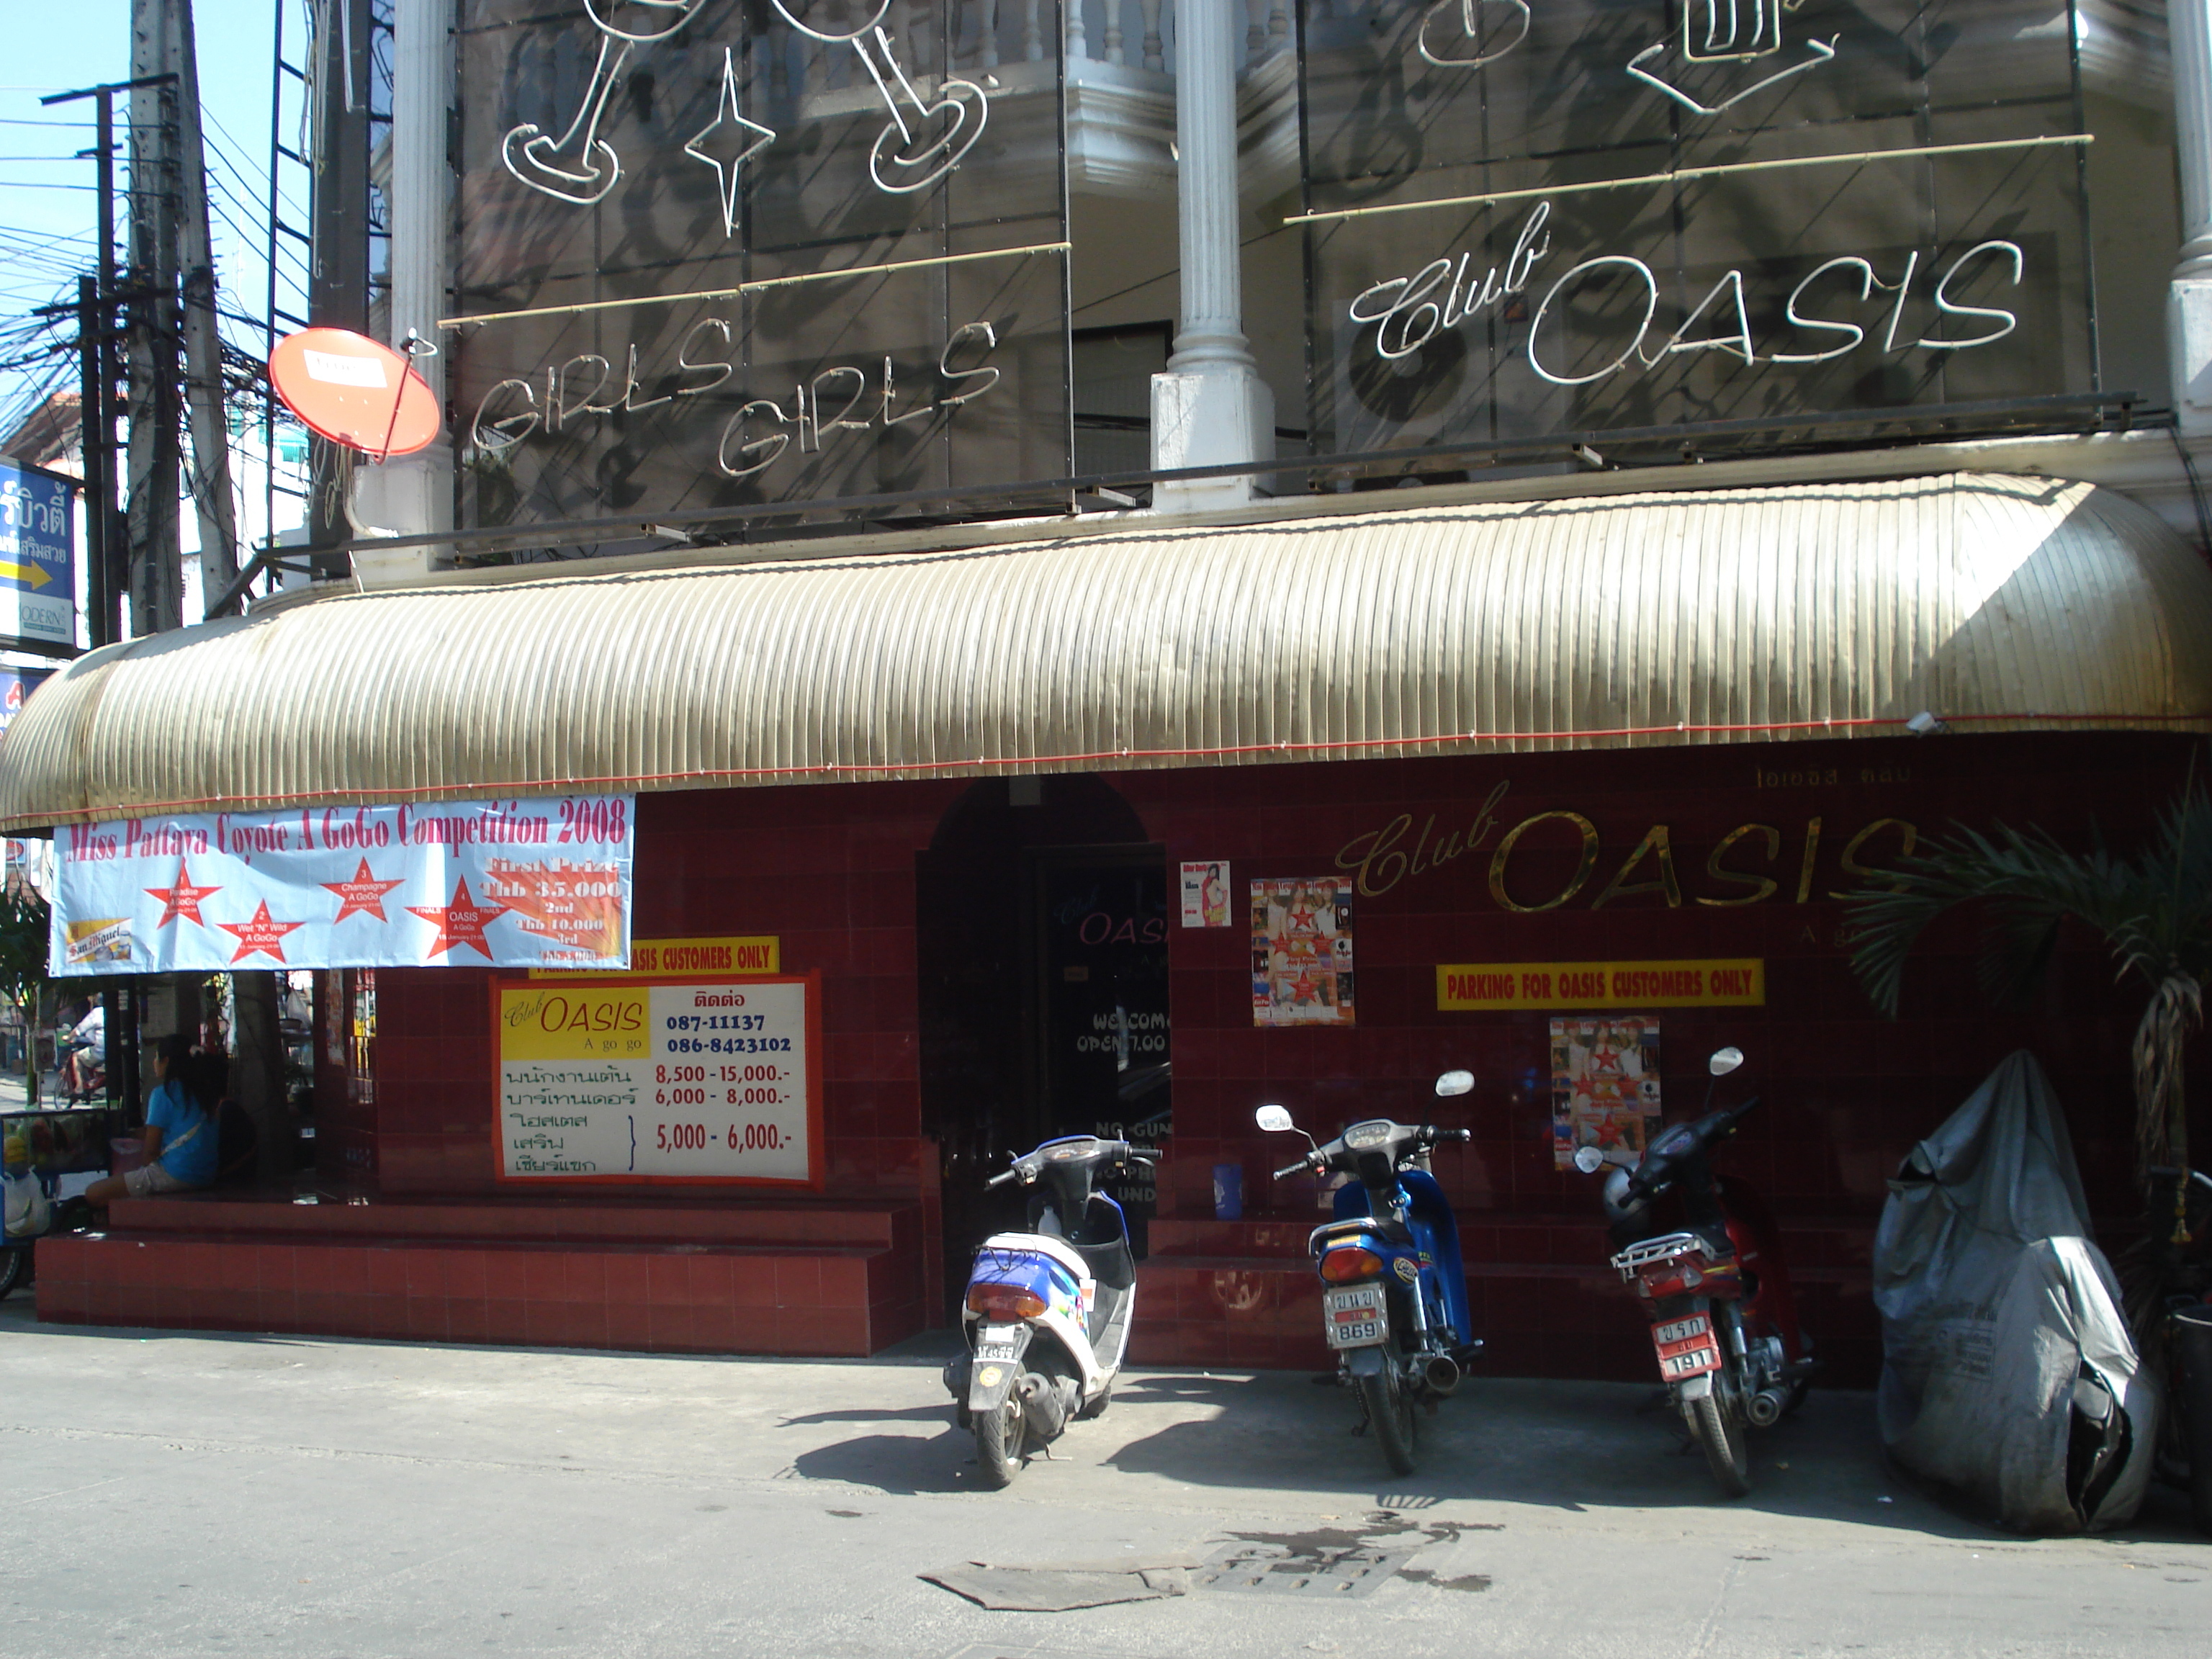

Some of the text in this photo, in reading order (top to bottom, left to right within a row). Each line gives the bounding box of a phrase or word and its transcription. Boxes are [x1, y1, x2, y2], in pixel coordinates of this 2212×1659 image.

[1350, 200, 2023, 385] Club OASIS
[472, 317, 734, 451] GIRLS
[719, 320, 999, 477] GIRLS
[19, 602, 60, 626] ODERN
[66, 799, 626, 866] Miss Pattaya Coyote A GoGo Competition 2008
[1335, 780, 1918, 913] Club OASIS
[361, 866, 367, 878] 3
[485, 858, 619, 873] First Prize
[341, 883, 387, 891] Champagne
[480, 881, 623, 898] Thb 35.000
[356, 892, 379, 901] GoGo
[258, 911, 265, 920] 2
[545, 902, 574, 914] 2nd
[449, 912, 478, 922] OASIS
[516, 919, 603, 930] Thb 10.000
[237, 924, 253, 932] Wet
[70, 925, 120, 957] San Miguel
[253, 933, 277, 942] GoGo
[558, 933, 578, 944] 3rd
[631, 945, 770, 971] ASIS CUSTOMERS ONLY
[1447, 969, 1753, 1000] PARKING FOR OASIS CUSTOMERS ONLY
[694, 989, 745, 1007] ติดต่อ
[504, 991, 642, 1032] Club OASIS
[667, 1015, 765, 1032] 087-11137
[585, 1038, 642, 1052] A go go
[667, 1038, 791, 1054] 086-8423102
[506, 1065, 631, 1083] พนักงานเต้น
[656, 1065, 705, 1084] 8,500
[720, 1065, 790, 1084] 15,000.-
[507, 1088, 639, 1105] บาร์เทนเดอร์
[655, 1089, 705, 1107] 6,000
[727, 1088, 791, 1107] 8,000.-
[1096, 1122, 1124, 1137] NO
[657, 1124, 706, 1154] 5,000
[728, 1124, 791, 1154] 6,000.-
[1340, 1323, 1375, 1340] 869
[1672, 1350, 1707, 1373] 191
